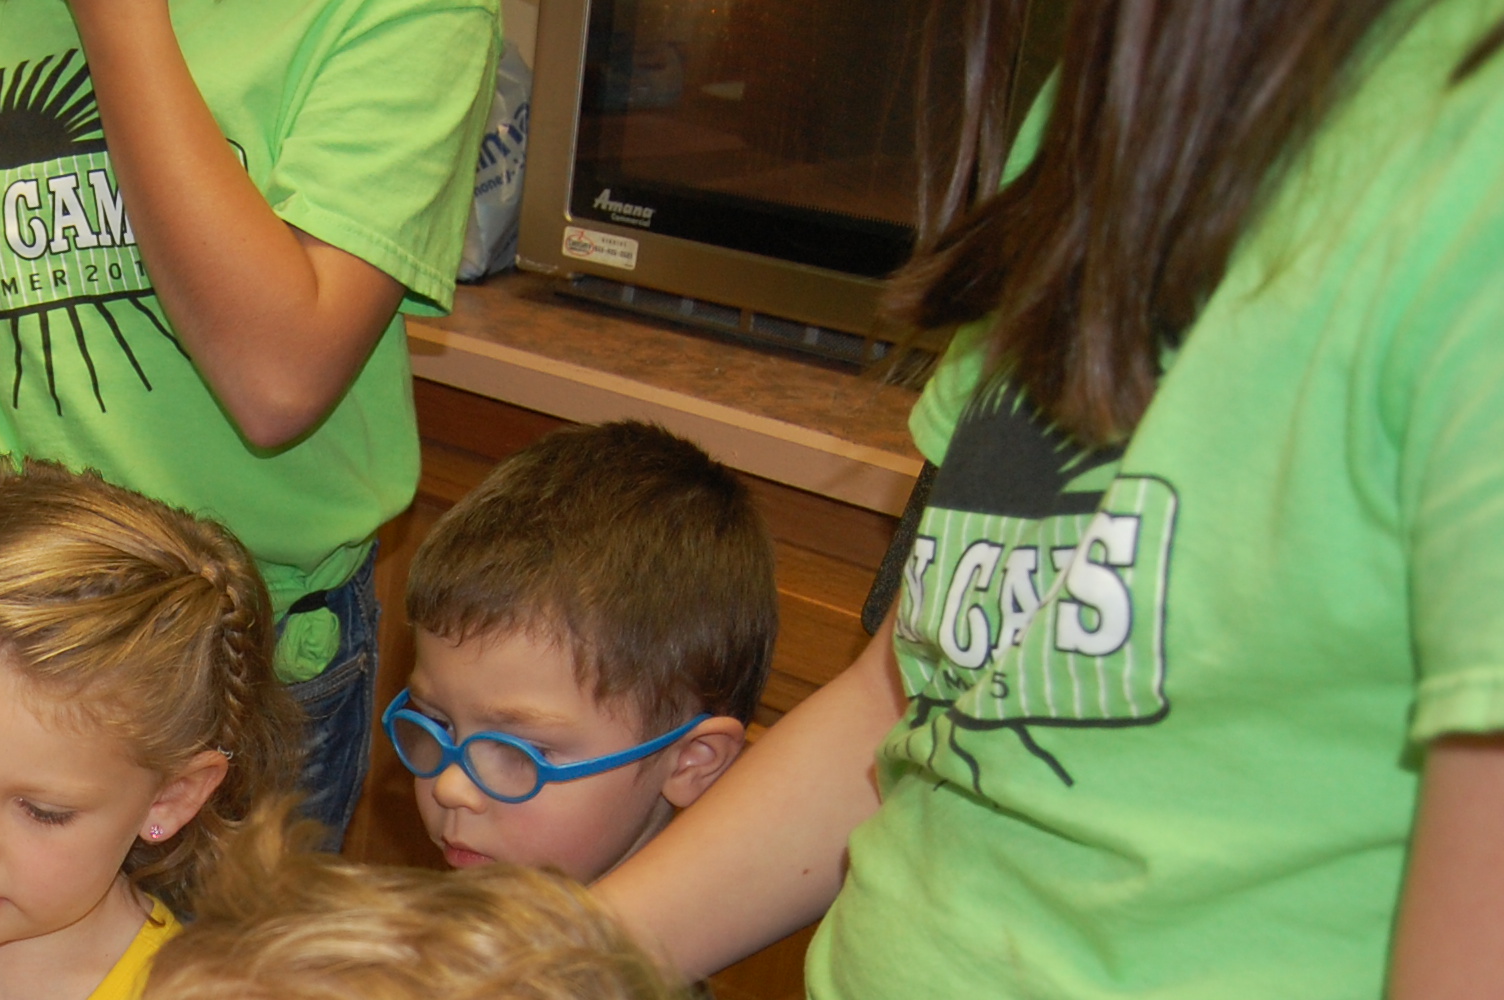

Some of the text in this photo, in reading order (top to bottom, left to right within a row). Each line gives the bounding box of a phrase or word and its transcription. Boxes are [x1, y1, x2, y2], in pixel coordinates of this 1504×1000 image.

[3, 168, 138, 261] CAM
[593, 188, 654, 219] Amana
[85, 260, 147, 284] 201
